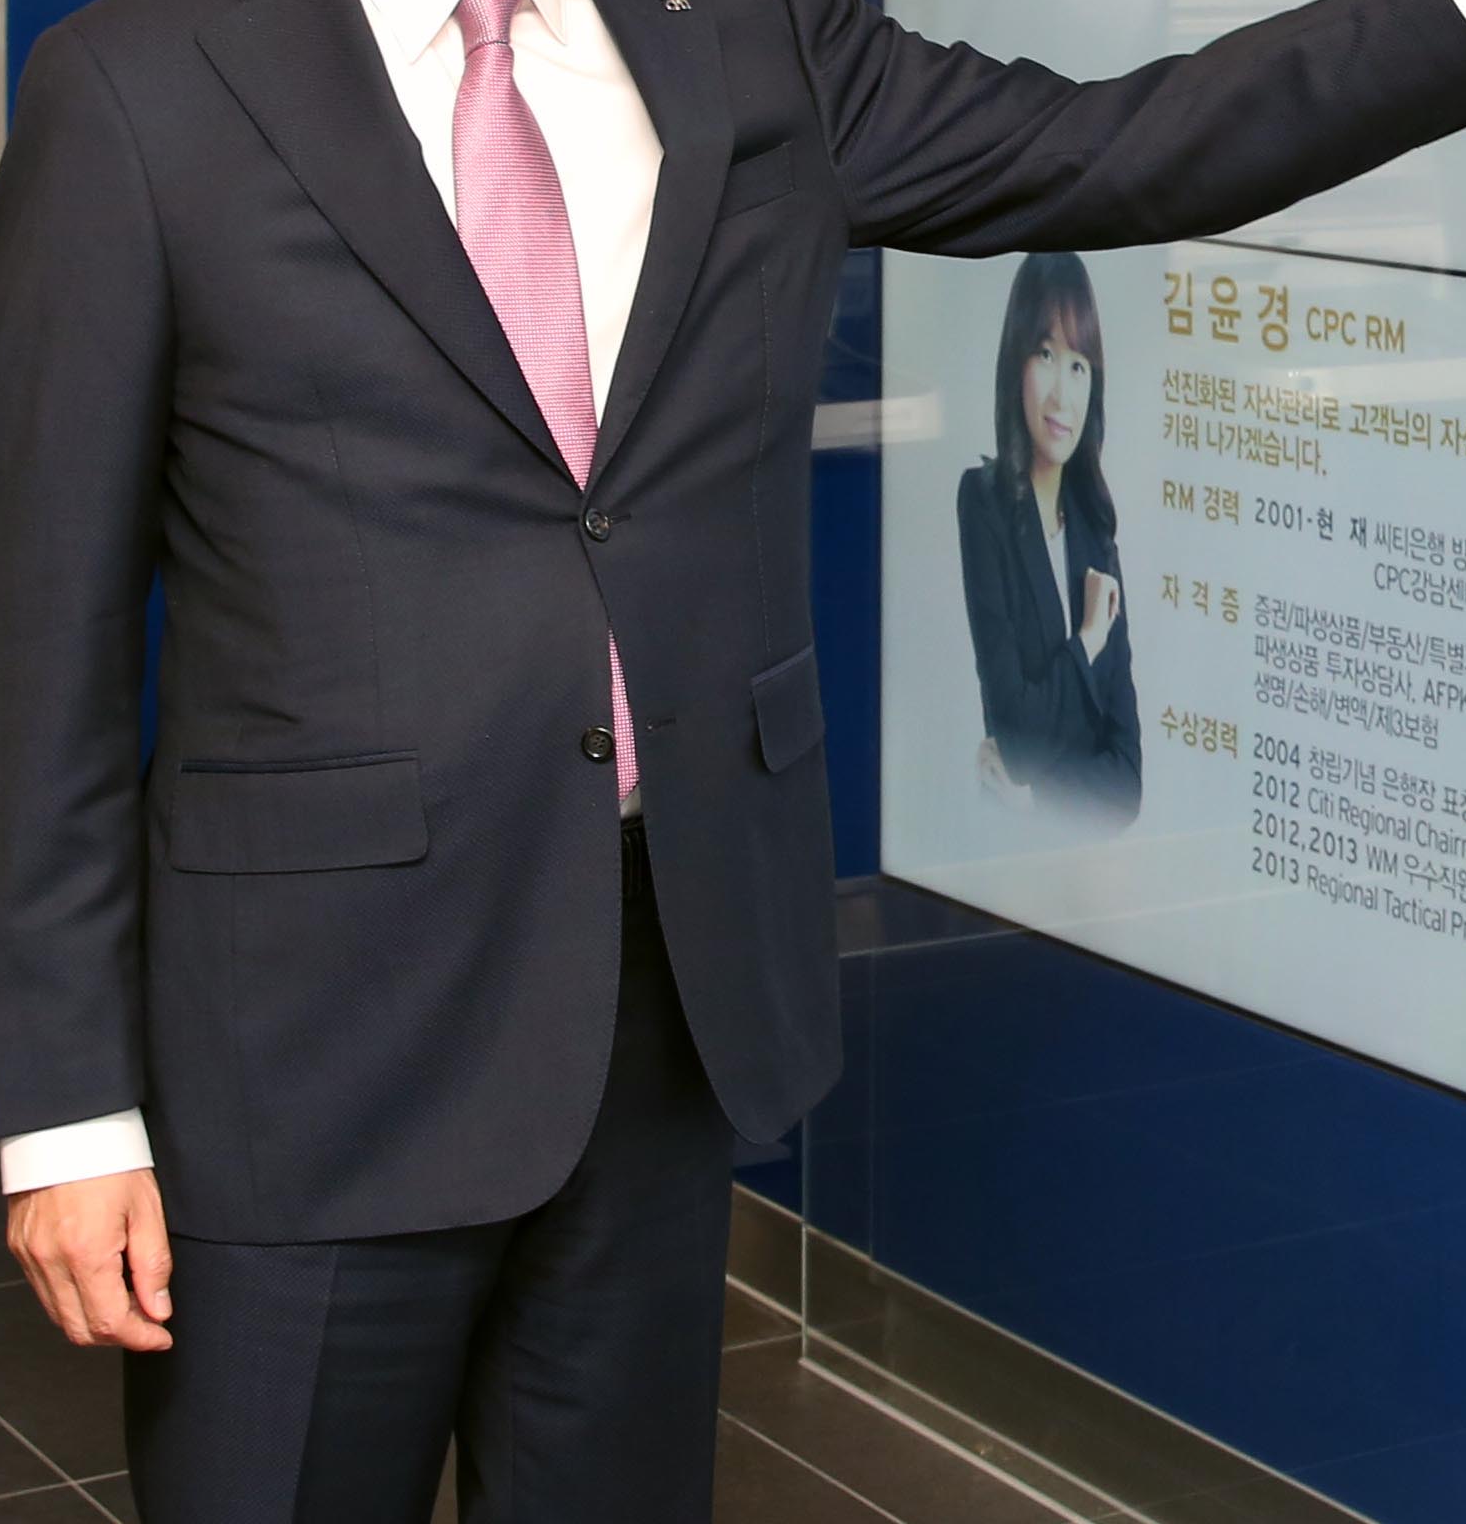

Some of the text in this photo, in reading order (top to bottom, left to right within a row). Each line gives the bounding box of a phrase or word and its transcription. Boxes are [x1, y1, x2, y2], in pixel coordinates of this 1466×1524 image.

[1305, 305, 1358, 347] CPC
[1365, 314, 1406, 354] RM
[1162, 368, 1236, 414] 선진화된
[1243, 382, 1341, 432] 자산관리로
[1348, 403, 1432, 452] 고객님의
[1162, 411, 1328, 476] 키워 나가겠습니다.
[1162, 479, 1195, 514] RM
[1203, 485, 1241, 527] 경력
[1374, 522, 1446, 568] 씨티은행
[1254, 634, 1320, 679] 파생상품
[1160, 704, 1239, 760] 수상경력
[1253, 731, 1301, 770] 2004
[1307, 744, 1377, 788] 창립기념
[1383, 766, 1436, 812] 은행장
[1252, 770, 1301, 810] 2012
[1307, 785, 1335, 820] Citi
[1338, 793, 1413, 844] Regional
[1252, 808, 1359, 866] 2012,2013
[1365, 842, 1400, 879] WM
[1251, 846, 1301, 886] 2013
[1306, 863, 1380, 913] Regional
[1382, 887, 1447, 935] Tactical
